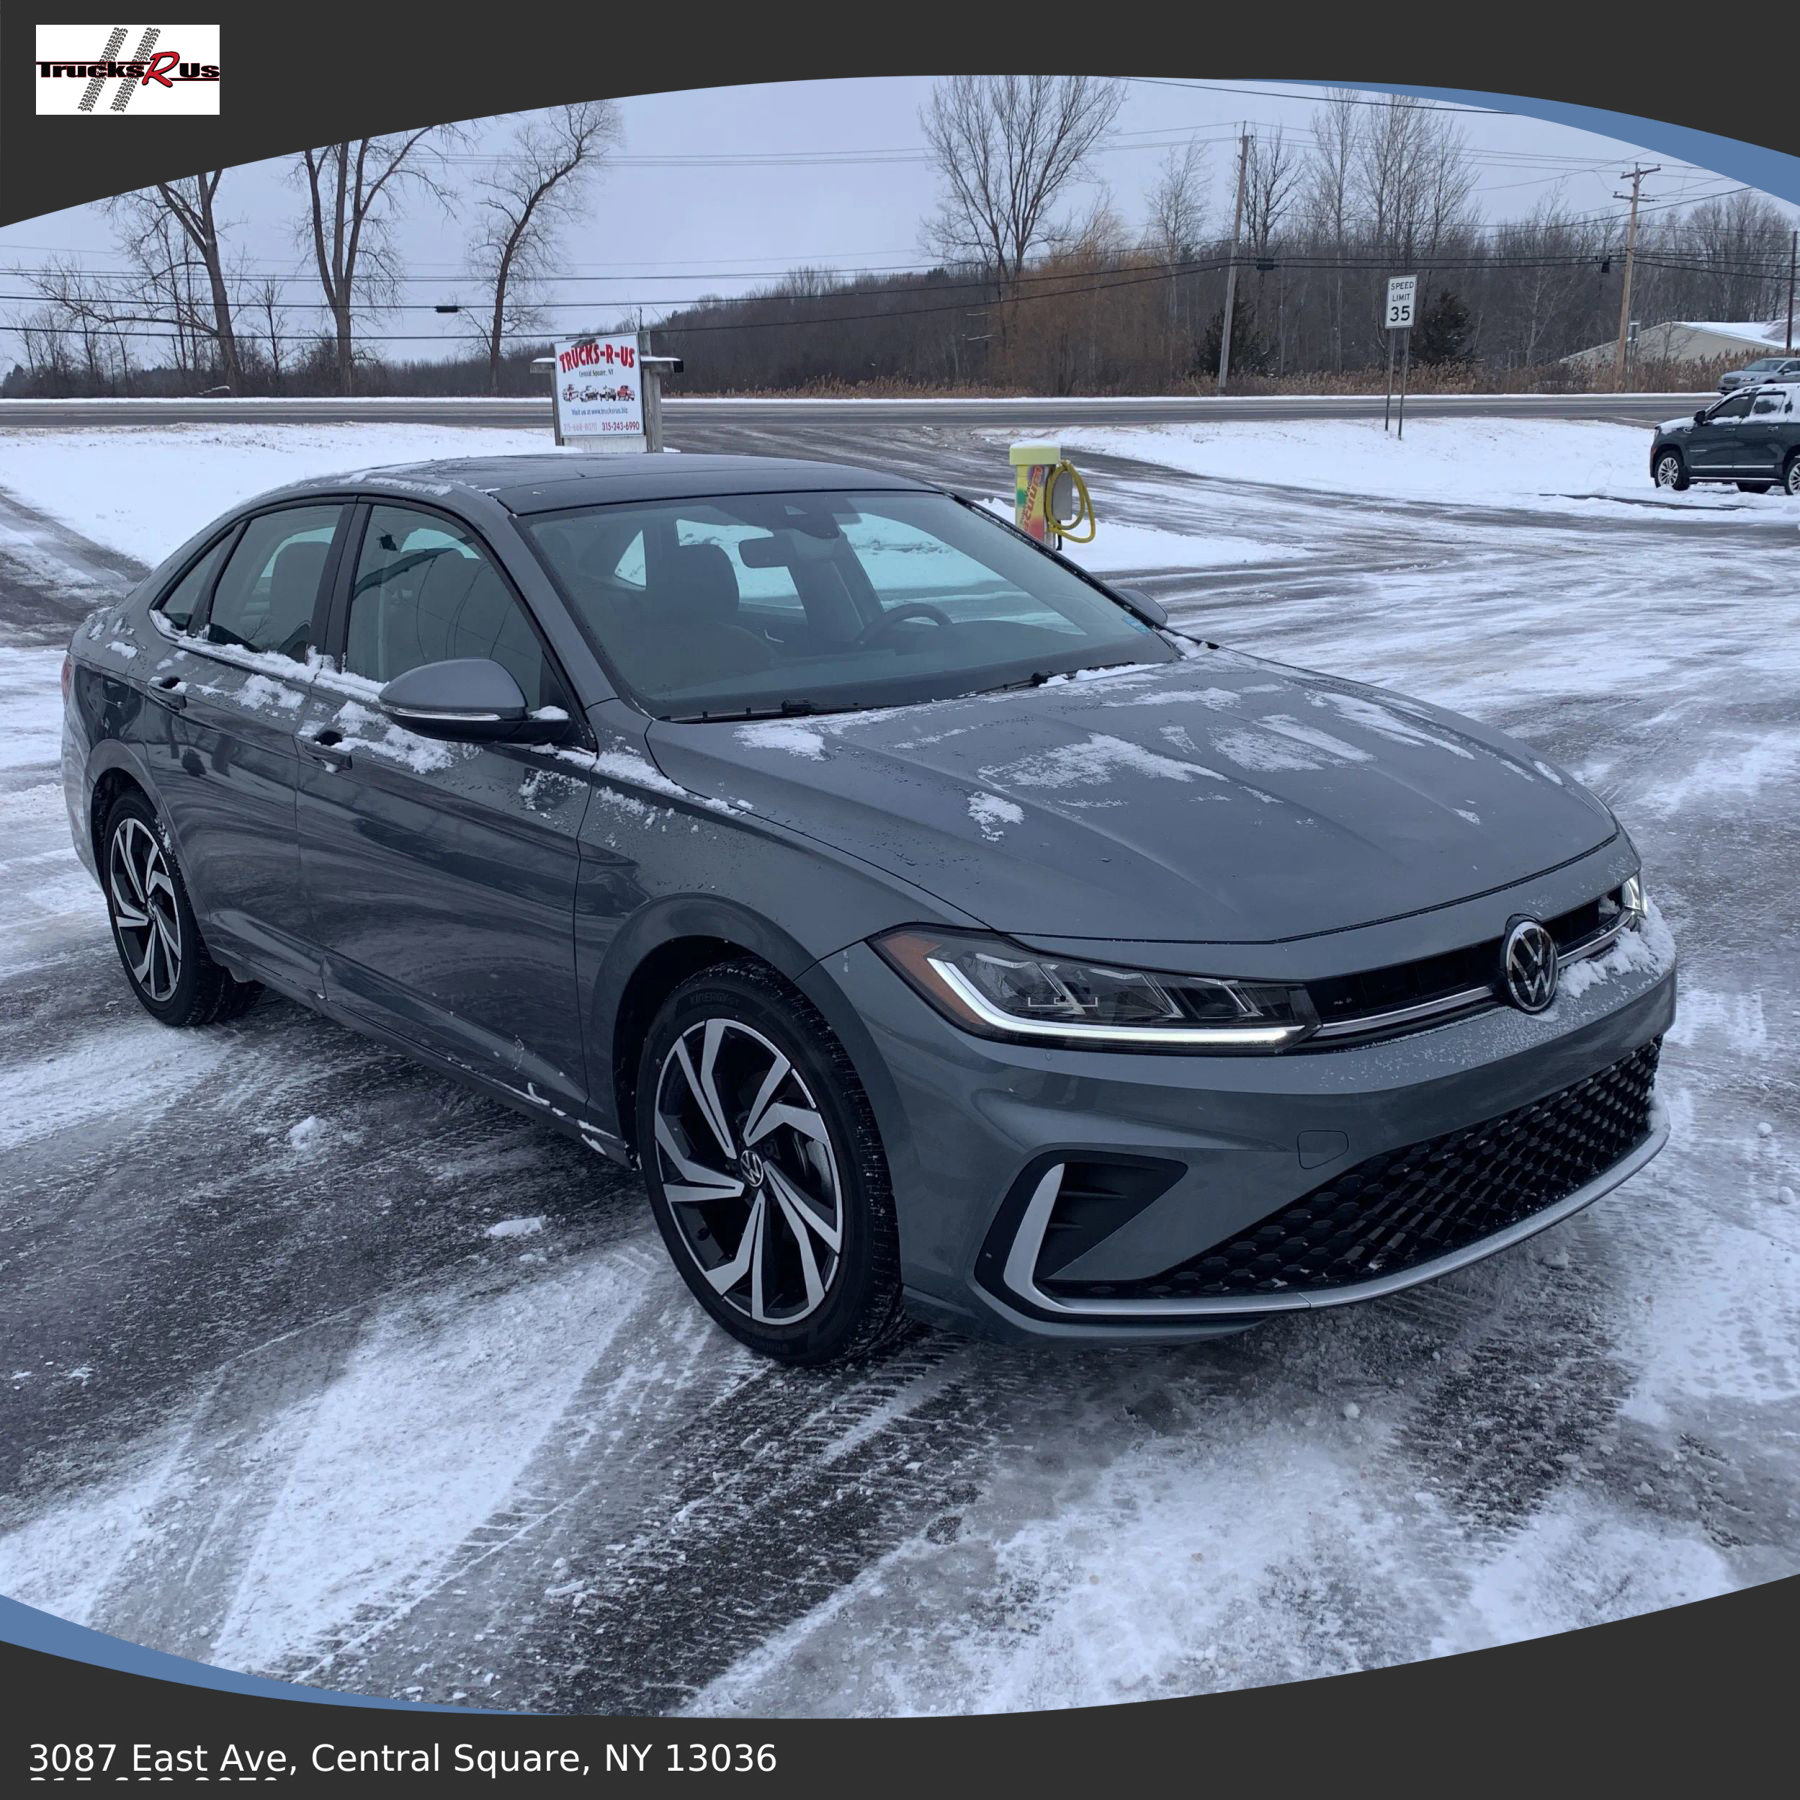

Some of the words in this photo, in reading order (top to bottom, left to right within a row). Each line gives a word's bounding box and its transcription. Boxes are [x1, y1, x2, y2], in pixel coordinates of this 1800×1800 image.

[1391, 281, 1414, 291] SPEED
[1392, 293, 1411, 302] LIMIT
[1390, 305, 1410, 322] 35
[559, 344, 635, 373] TRUCKS-R-US
[602, 421, 640, 432] 315-243-6990
